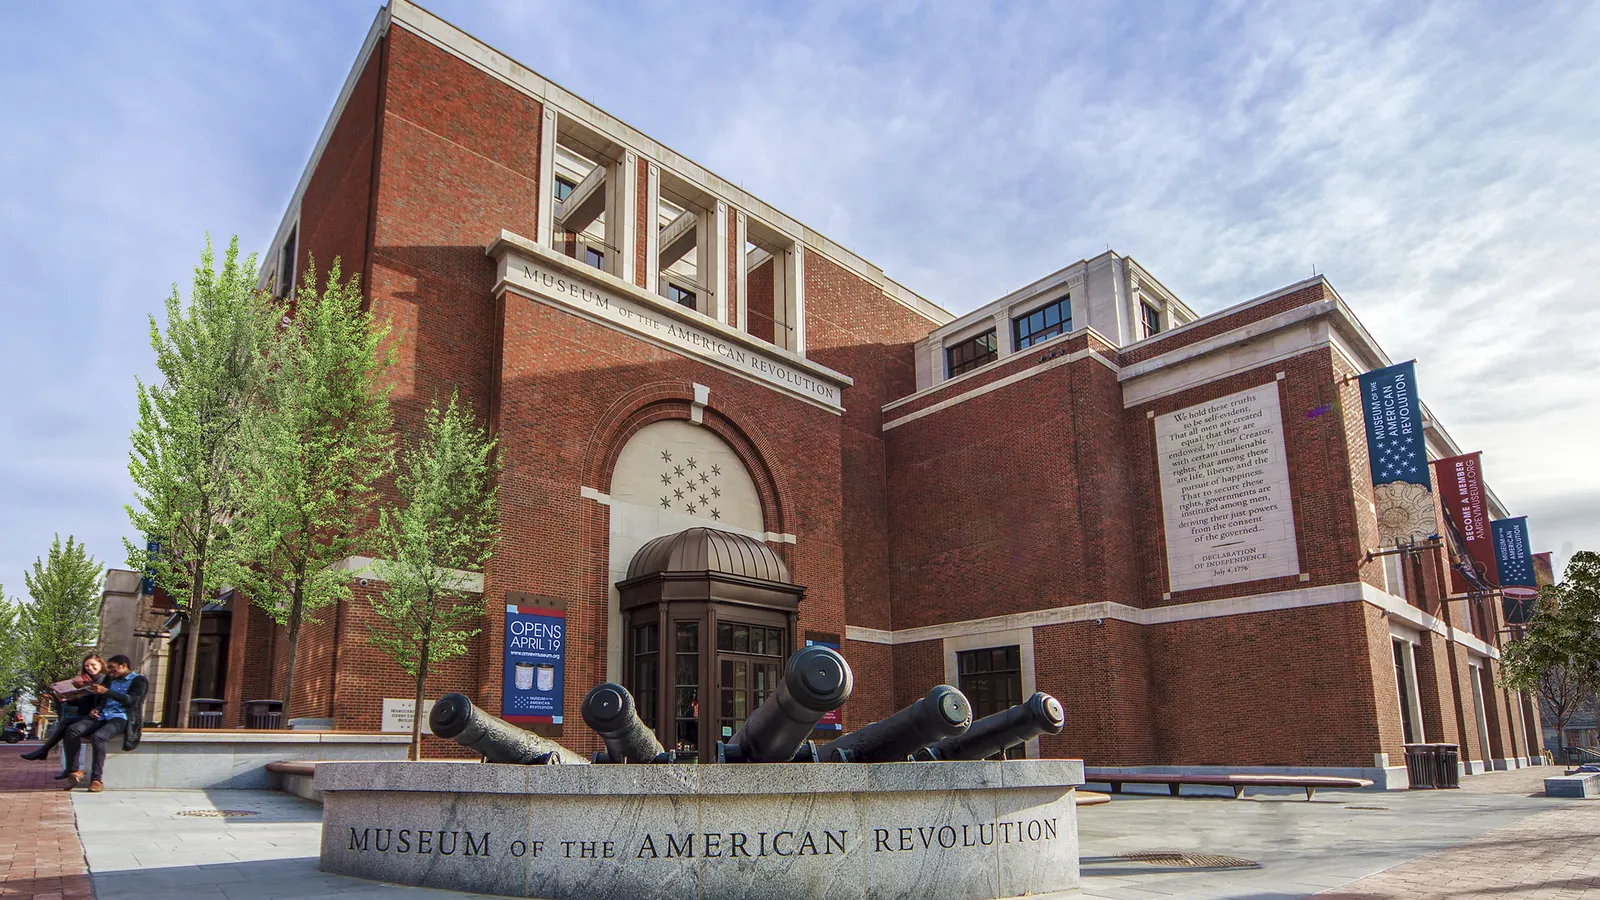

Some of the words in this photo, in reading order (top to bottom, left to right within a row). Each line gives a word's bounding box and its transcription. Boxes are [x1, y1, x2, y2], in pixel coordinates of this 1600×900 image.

[524, 265, 609, 310] MUSEUM
[618, 307, 634, 319] OF
[637, 313, 659, 330] THE
[667, 324, 746, 364] AMERICAN
[750, 356, 834, 399] REVOLUTION
[1174, 413, 1188, 422] We
[1189, 408, 1207, 420] hold
[1208, 402, 1228, 414] these
[1230, 395, 1256, 407] truths
[1372, 393, 1378, 401] OF
[1395, 373, 1413, 434] REVOLUTION
[1193, 418, 1202, 427] be
[1204, 406, 1251, 424] self-evident,
[1372, 400, 1385, 440] MUSEUM
[1383, 385, 1398, 436] AMERICAN
[1169, 432, 1187, 441] That
[1189, 428, 1198, 436] all
[1200, 424, 1218, 433] men
[1220, 419, 1231, 427] are
[1233, 410, 1262, 424] created
[1206, 431, 1222, 440] that
[1224, 425, 1240, 436] they
[1243, 422, 1255, 430] are
[1168, 445, 1205, 459] endowed,
[1206, 442, 1216, 450] by
[1217, 436, 1237, 446] their
[1239, 427, 1273, 441] Creator,
[1172, 457, 1189, 468] with
[1191, 451, 1218, 463] certain
[1220, 438, 1267, 455] unalienable
[1176, 476, 1188, 484] are
[1189, 472, 1205, 481] life,
[1207, 466, 1235, 476] liberty,
[1236, 460, 1252, 470] and
[1254, 457, 1268, 466] the
[1198, 461, 1214, 470] that
[1216, 454, 1244, 465] among
[1247, 447, 1268, 457] these
[1181, 482, 1209, 494] pursuit
[1211, 477, 1220, 486] of
[1222, 468, 1264, 483] happiness.
[1181, 492, 1200, 502] That
[1214, 484, 1240, 493] secure
[1242, 478, 1264, 488] these
[1455, 461, 1468, 495] MEMBER
[1179, 501, 1204, 511] rights,
[1205, 490, 1256, 506] governments
[1181, 505, 1218, 518] instituted
[1220, 500, 1248, 510] among
[1250, 495, 1271, 504] men,
[1465, 459, 1485, 540] AMREVMUSEUM.ORG
[1178, 517, 1208, 529] deriving
[1210, 514, 1228, 522] their
[1230, 510, 1246, 520] just
[1248, 504, 1278, 516] powers
[1191, 524, 1211, 535] from
[1213, 522, 1226, 530] the
[1228, 516, 1263, 528] consent
[1462, 506, 1475, 540] BECOME
[1194, 535, 1204, 543] of
[1205, 532, 1219, 541] the
[1220, 527, 1265, 539] governed...
[1506, 530, 1516, 560] AMERICAN
[1513, 525, 1524, 559] REVOLUTION
[1202, 547, 1257, 562] DECLARATION
[1207, 553, 1267, 568] INDEPENDENCE
[1500, 538, 1508, 561] MUSEUM
[510, 621, 561, 639] OPENS
[510, 636, 544, 650] APRIL
[548, 640, 560, 651] 19
[348, 827, 491, 857] MUSEUM
[510, 840, 544, 858] OF
[560, 841, 616, 859] THE
[636, 830, 848, 859] AMERICAN
[873, 818, 1058, 853] REVOLUTION
